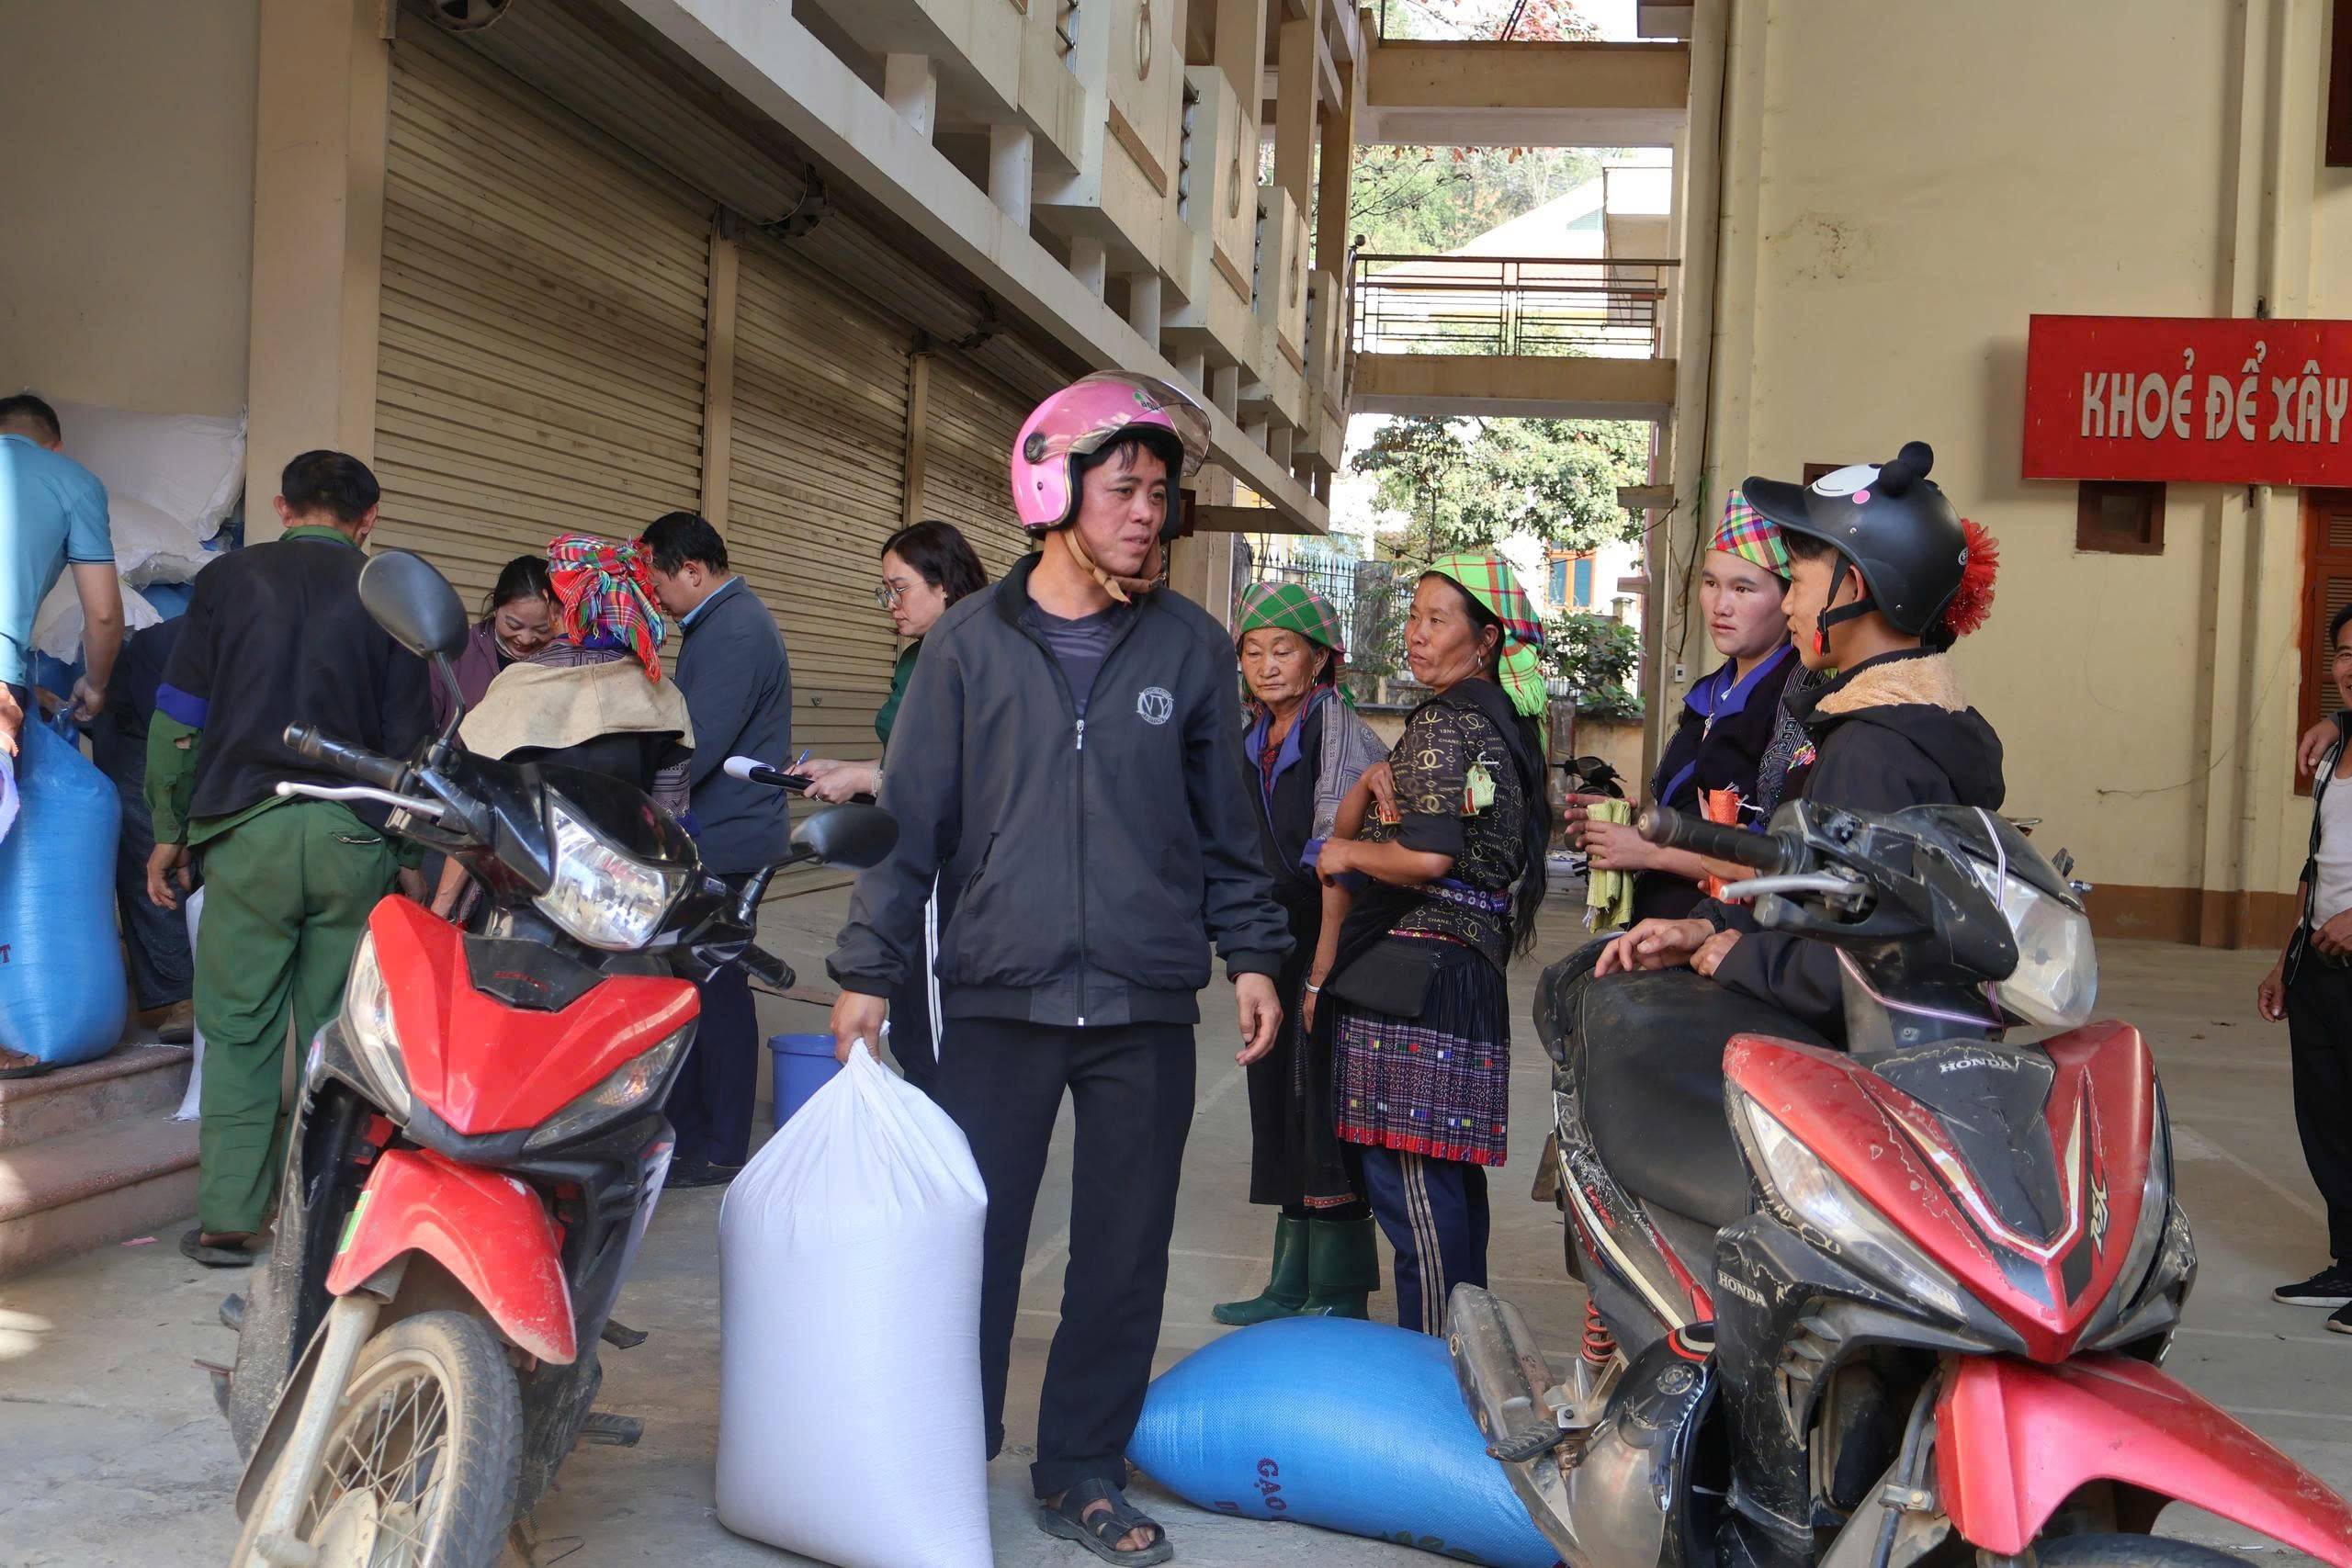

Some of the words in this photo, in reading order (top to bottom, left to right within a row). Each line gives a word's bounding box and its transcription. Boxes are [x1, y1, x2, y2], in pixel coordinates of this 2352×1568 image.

[2081, 347, 2196, 440] KHOẺ
[2205, 340, 2267, 441] ĐỂ
[2269, 359, 2348, 444] XÂY
[1427, 918, 1453, 926] CHANEL
[1939, 1058, 2015, 1074] HONDA
[1718, 1271, 1769, 1308] HONDA
